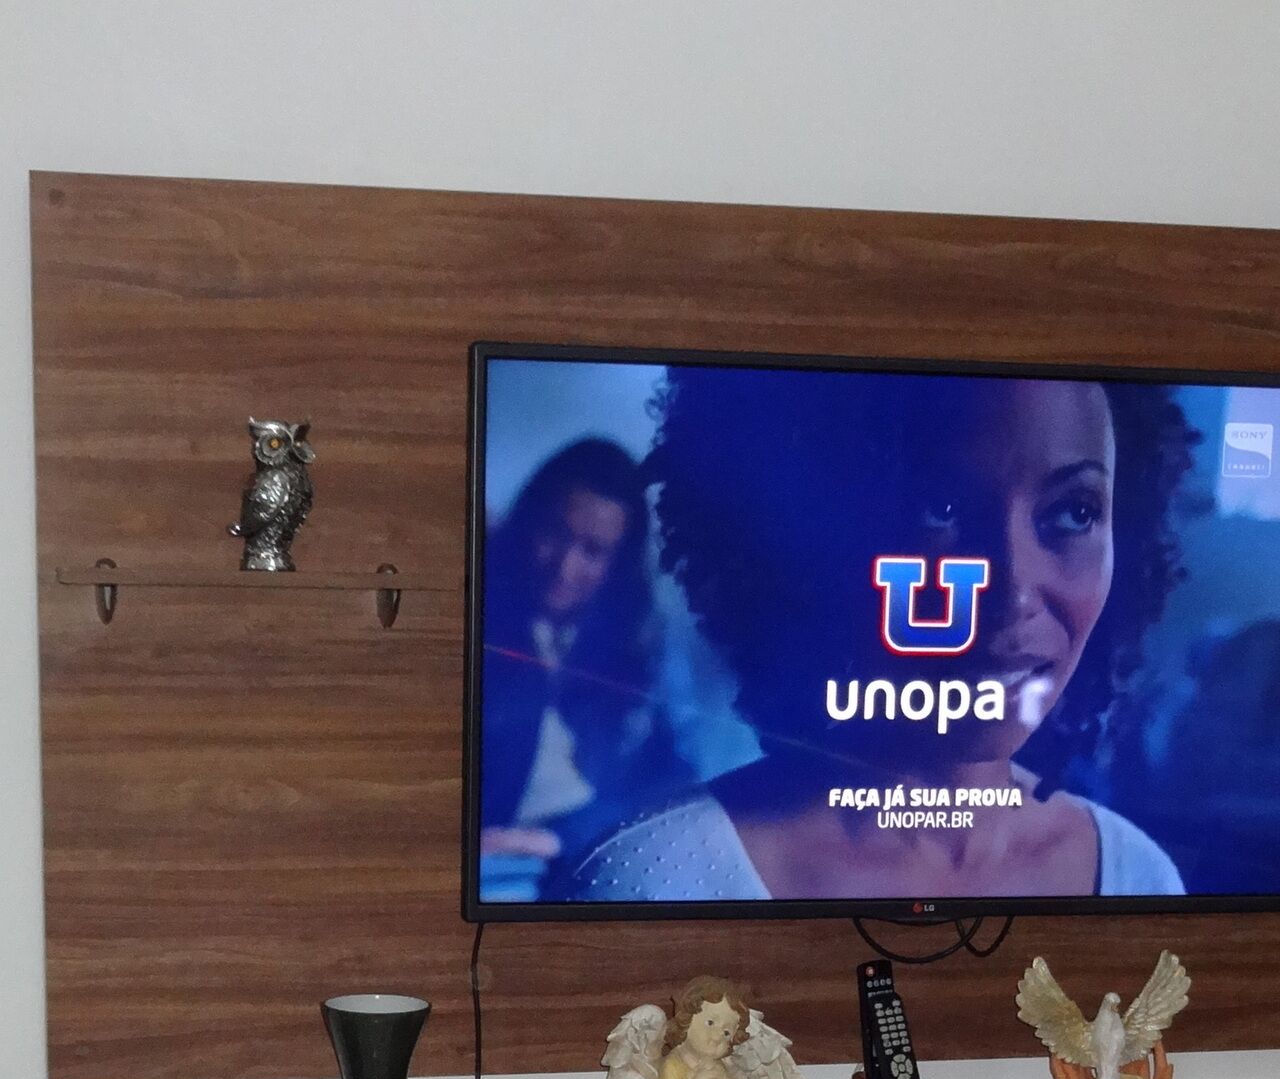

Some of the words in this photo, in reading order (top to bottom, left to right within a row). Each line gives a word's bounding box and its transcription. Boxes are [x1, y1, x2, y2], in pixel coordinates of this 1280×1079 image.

[1231, 431, 1268, 439] SONY
[870, 555, 990, 657] U
[828, 788, 880, 811] FAÇA
[882, 784, 904, 810] JÁ
[910, 788, 951, 807] SUA
[955, 788, 1023, 807] PROVA
[877, 811, 974, 829] UNOPAR.BR
[923, 904, 935, 912] LG
